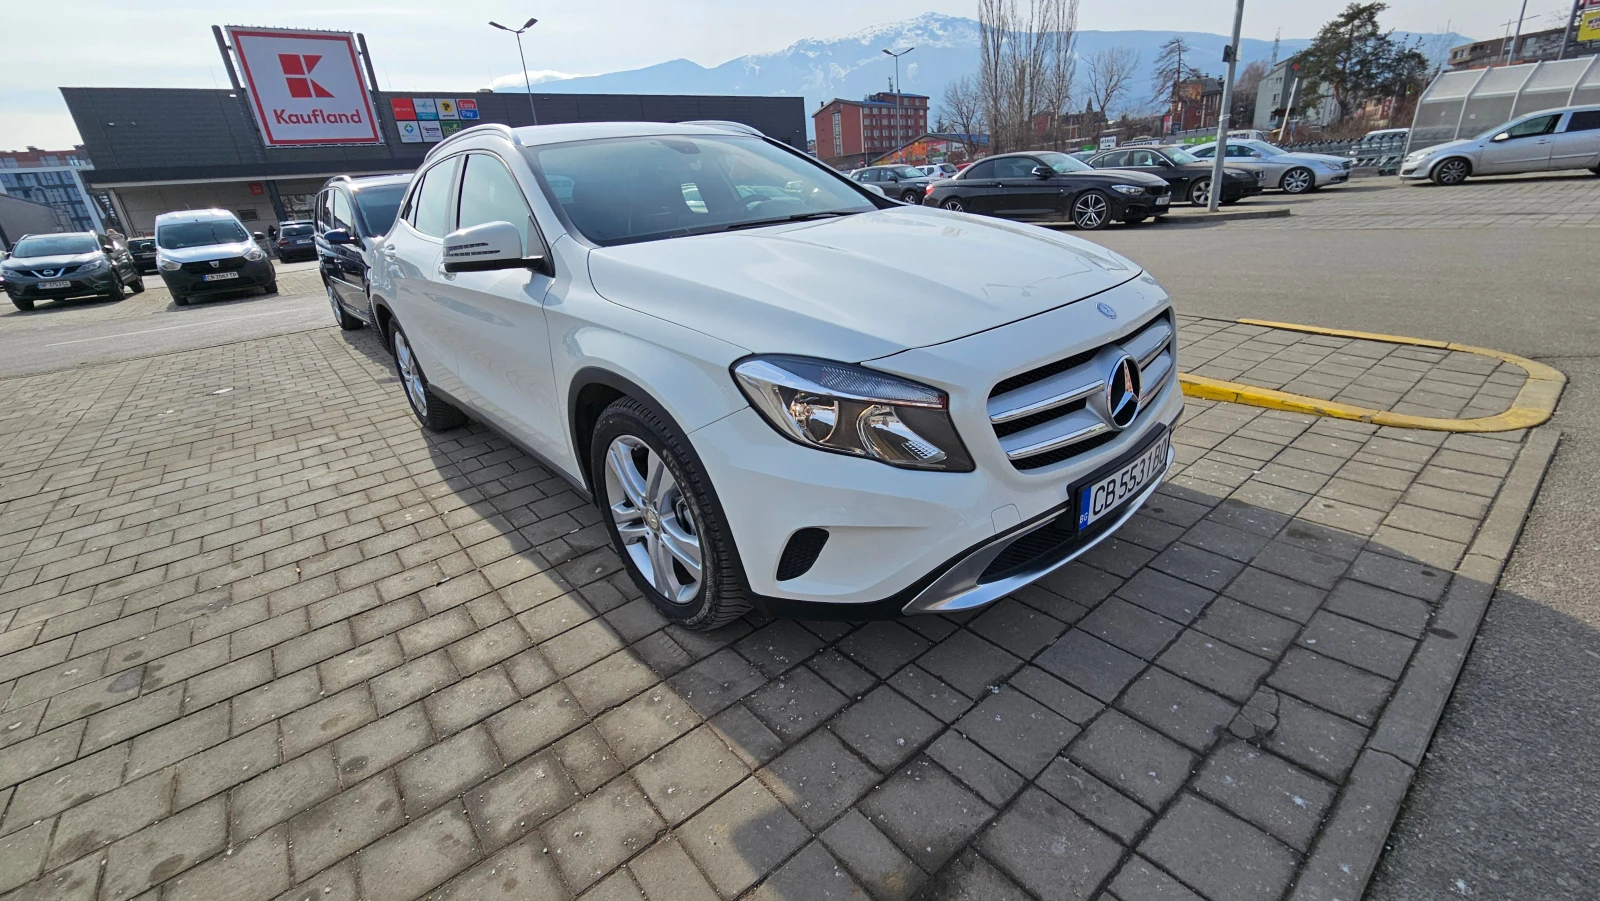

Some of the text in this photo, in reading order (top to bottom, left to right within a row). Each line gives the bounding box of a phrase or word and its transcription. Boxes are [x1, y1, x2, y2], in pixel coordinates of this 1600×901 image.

[459, 101, 475, 109] Easy
[272, 108, 363, 125] Kaufland
[1092, 479, 1117, 516] CB
[1118, 451, 1152, 500] 5531
[1079, 512, 1089, 524] BG
